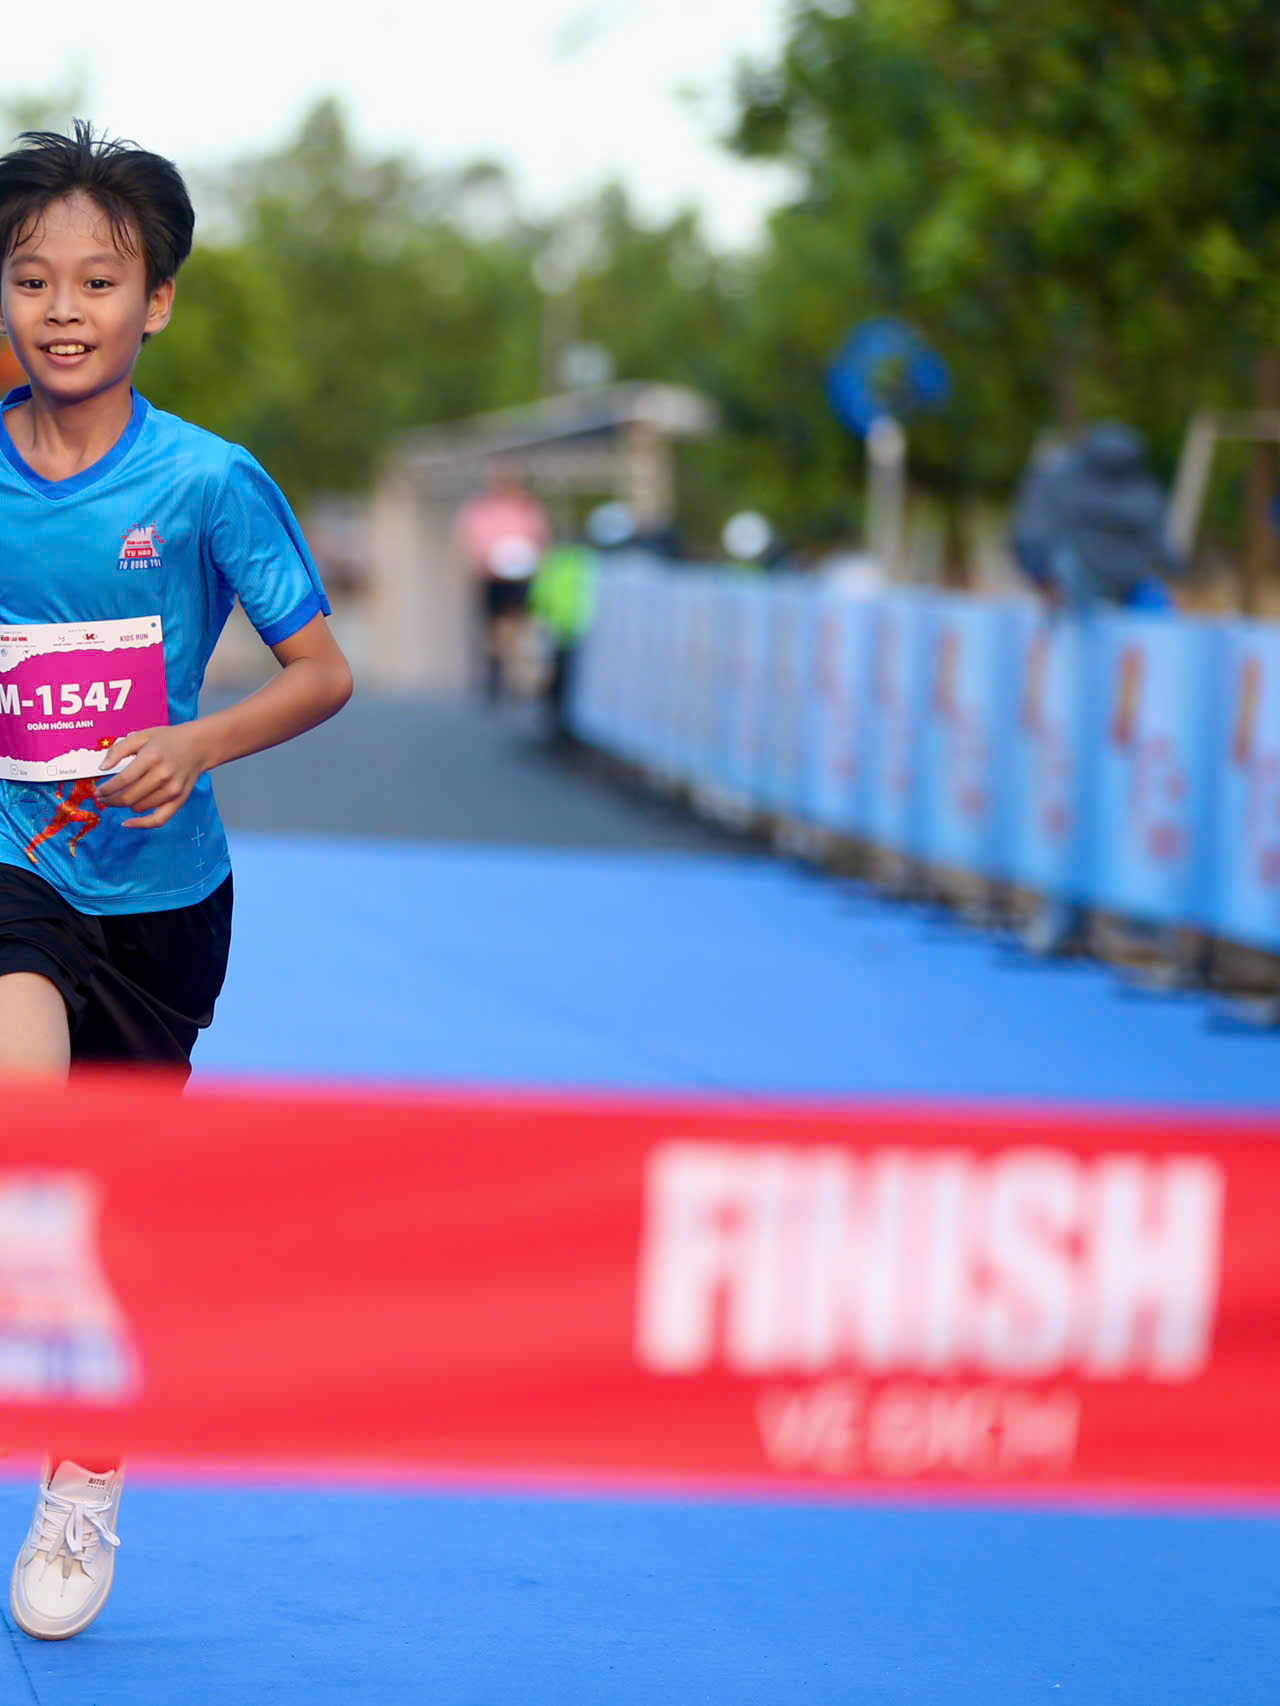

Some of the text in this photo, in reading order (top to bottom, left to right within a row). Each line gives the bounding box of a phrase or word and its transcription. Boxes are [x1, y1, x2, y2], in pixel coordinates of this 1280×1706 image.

[120, 633, 149, 642] KIDS RUN
[27, 721, 49, 730] ĐOÀN
[75, 719, 94, 729] ANH
[636, 1140, 1226, 1380] FINISH
